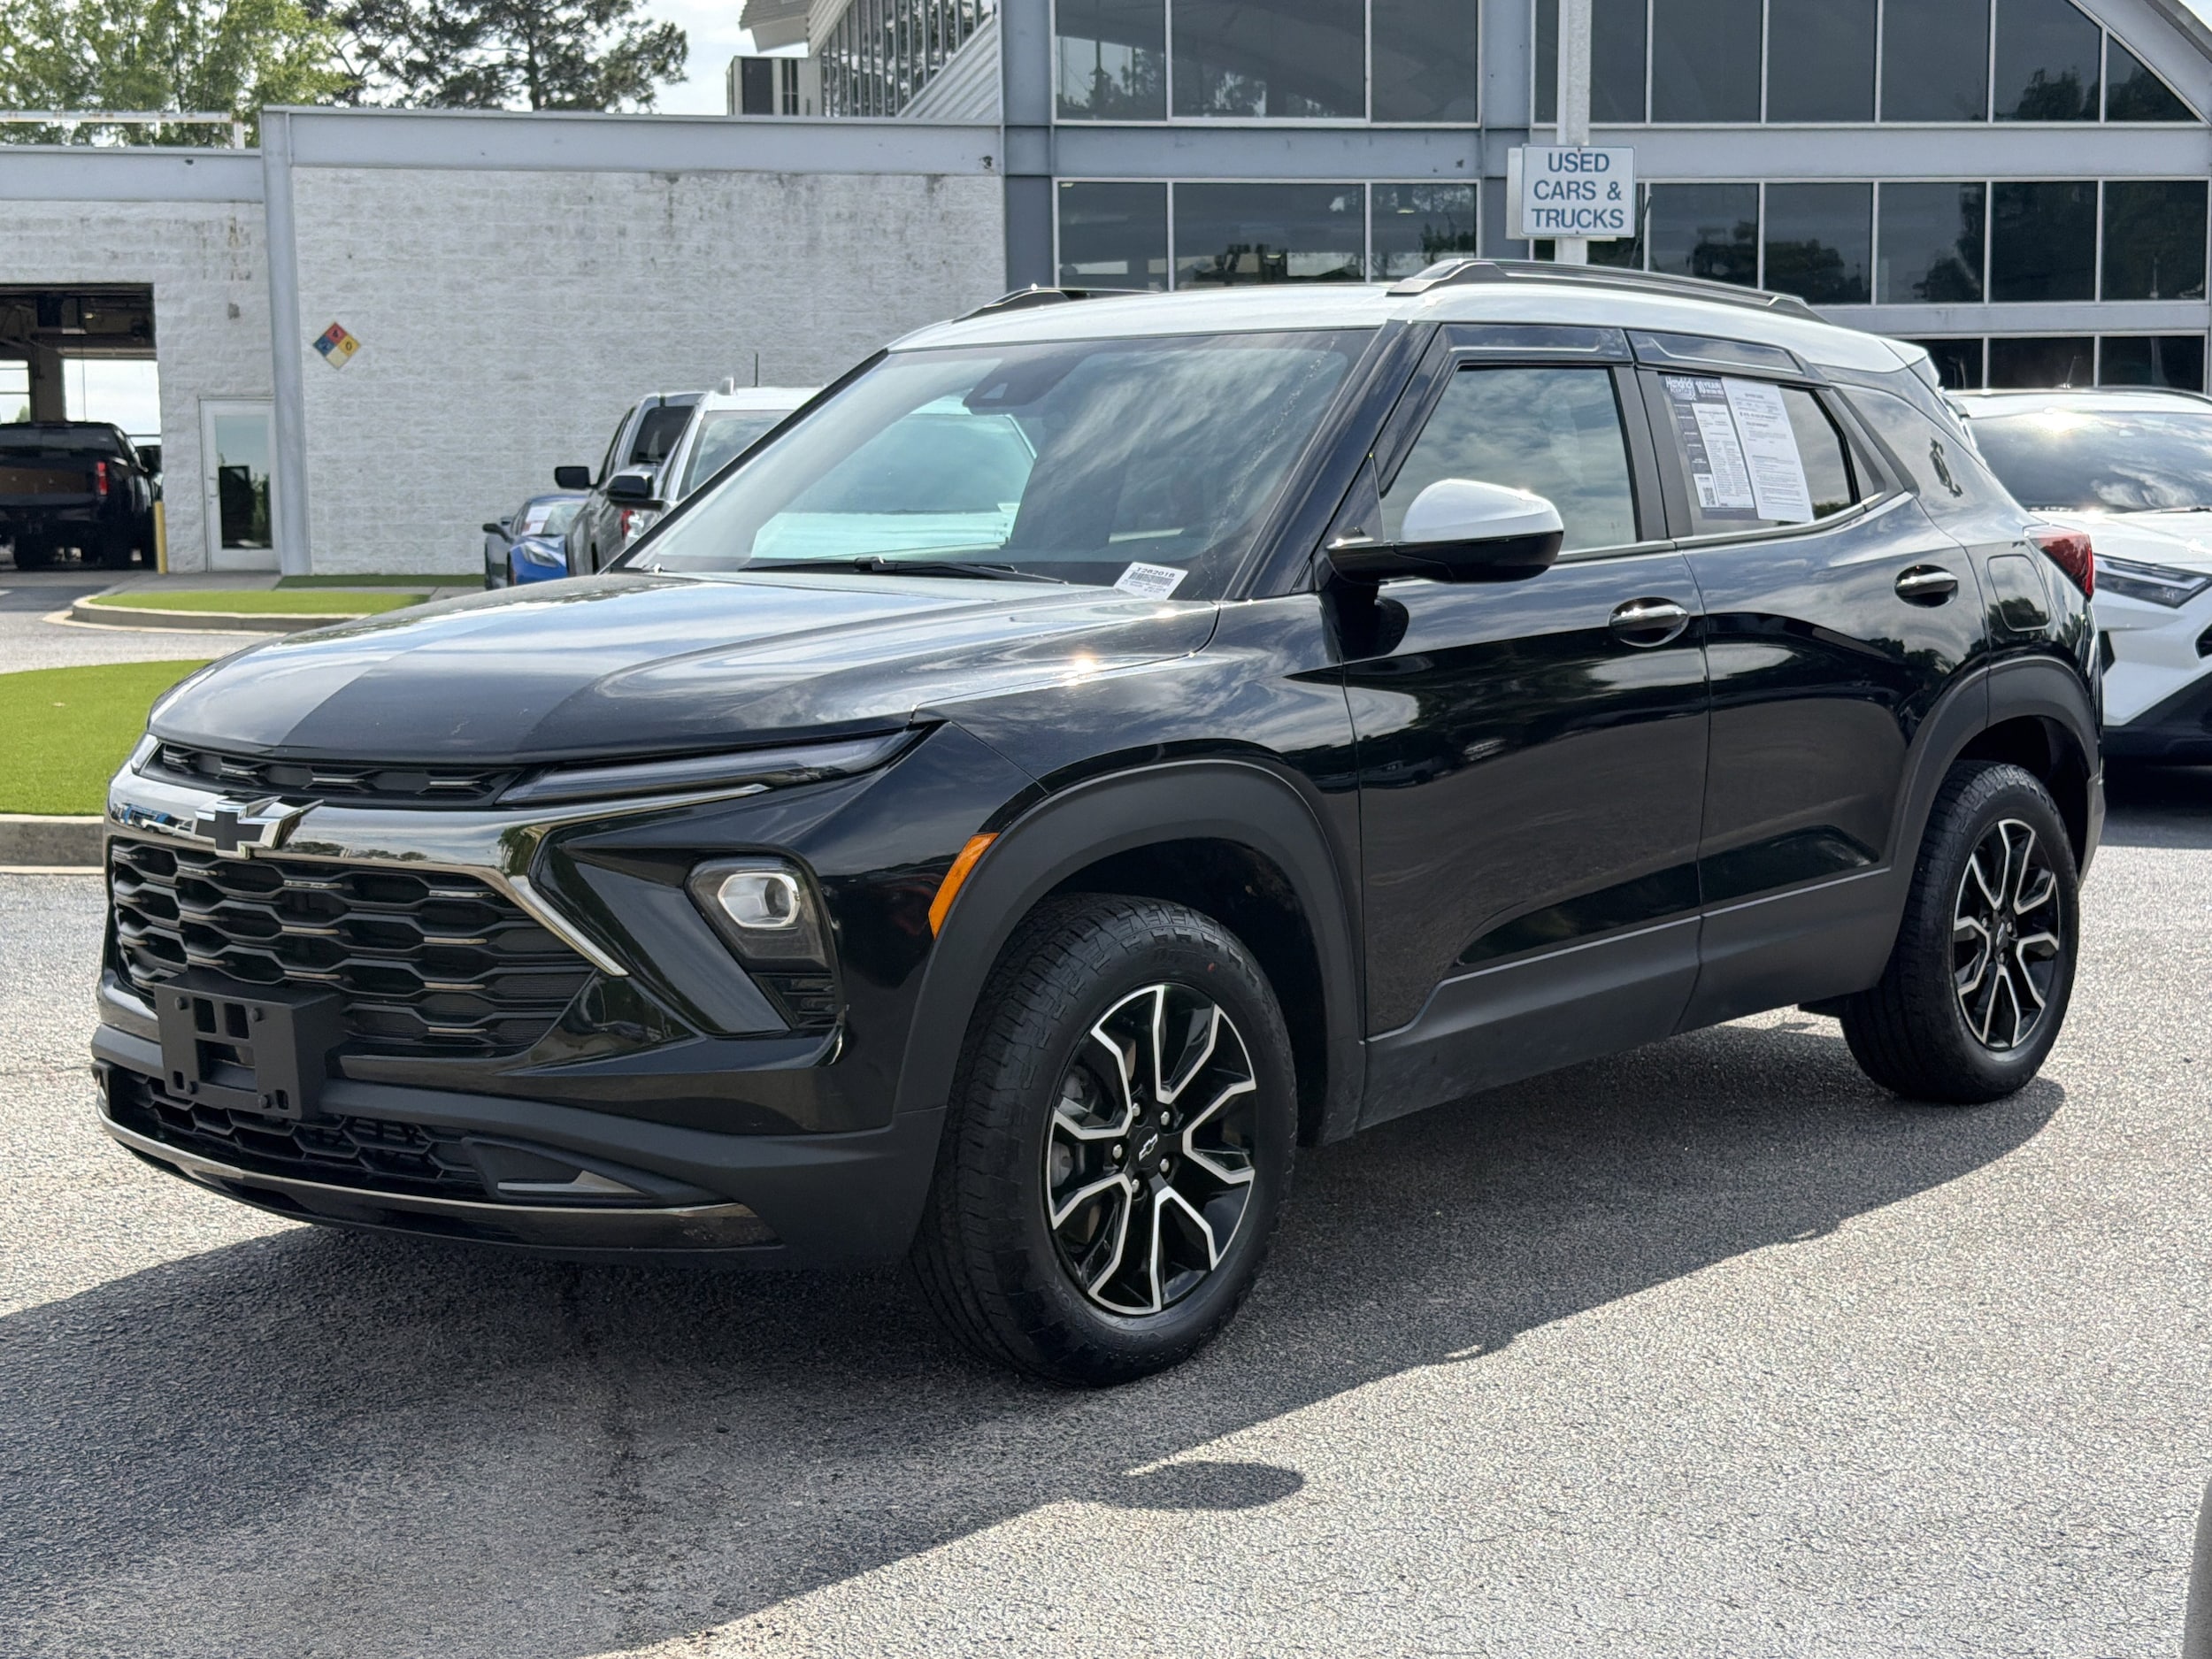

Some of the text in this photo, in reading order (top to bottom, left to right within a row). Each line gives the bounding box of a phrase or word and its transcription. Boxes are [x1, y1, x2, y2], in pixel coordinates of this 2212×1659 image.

[1548, 152, 1609, 173] USED
[1533, 180, 1621, 200] CARS &
[1532, 208, 1624, 228] TRUCKS
[346, 342, 352, 351] 0
